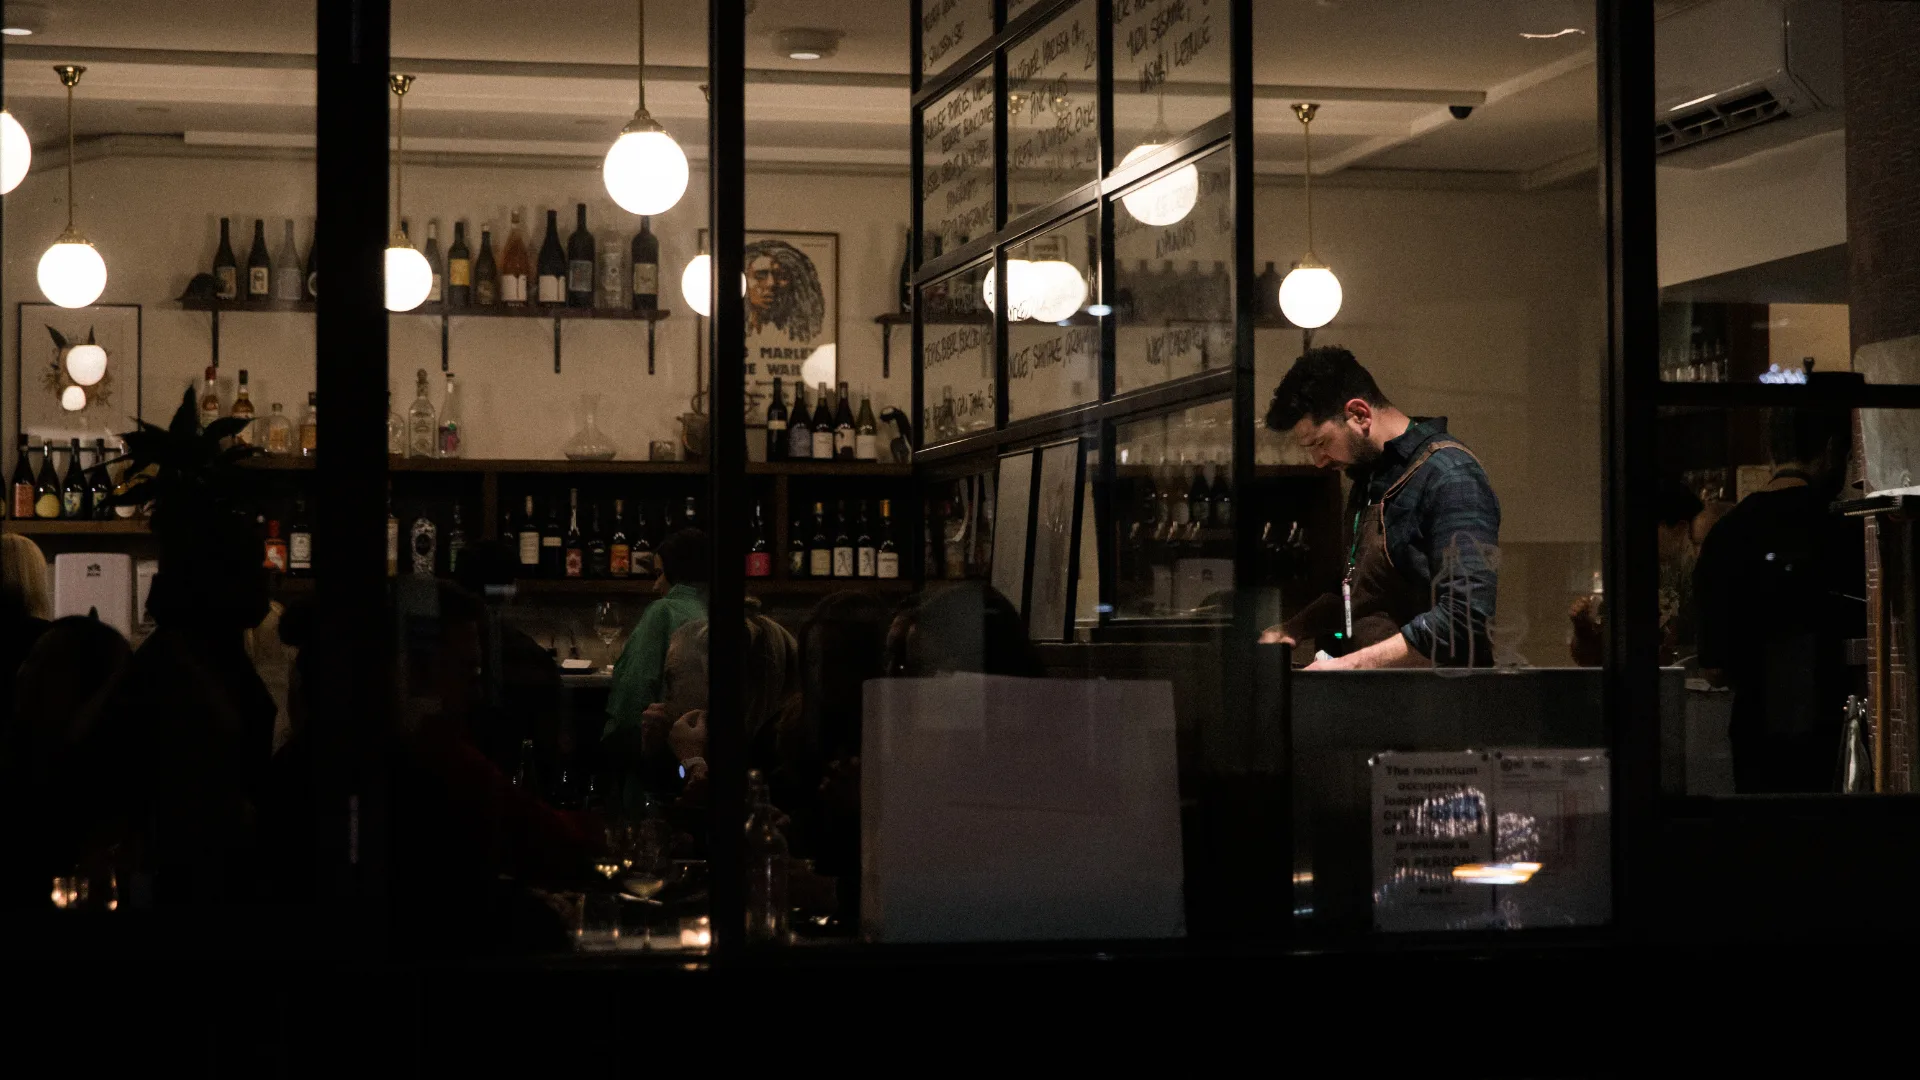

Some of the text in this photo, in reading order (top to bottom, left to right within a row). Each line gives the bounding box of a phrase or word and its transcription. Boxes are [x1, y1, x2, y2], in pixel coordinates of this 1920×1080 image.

[1386, 766, 1478, 776] The maximum
[1397, 782, 1467, 793] occupancy
